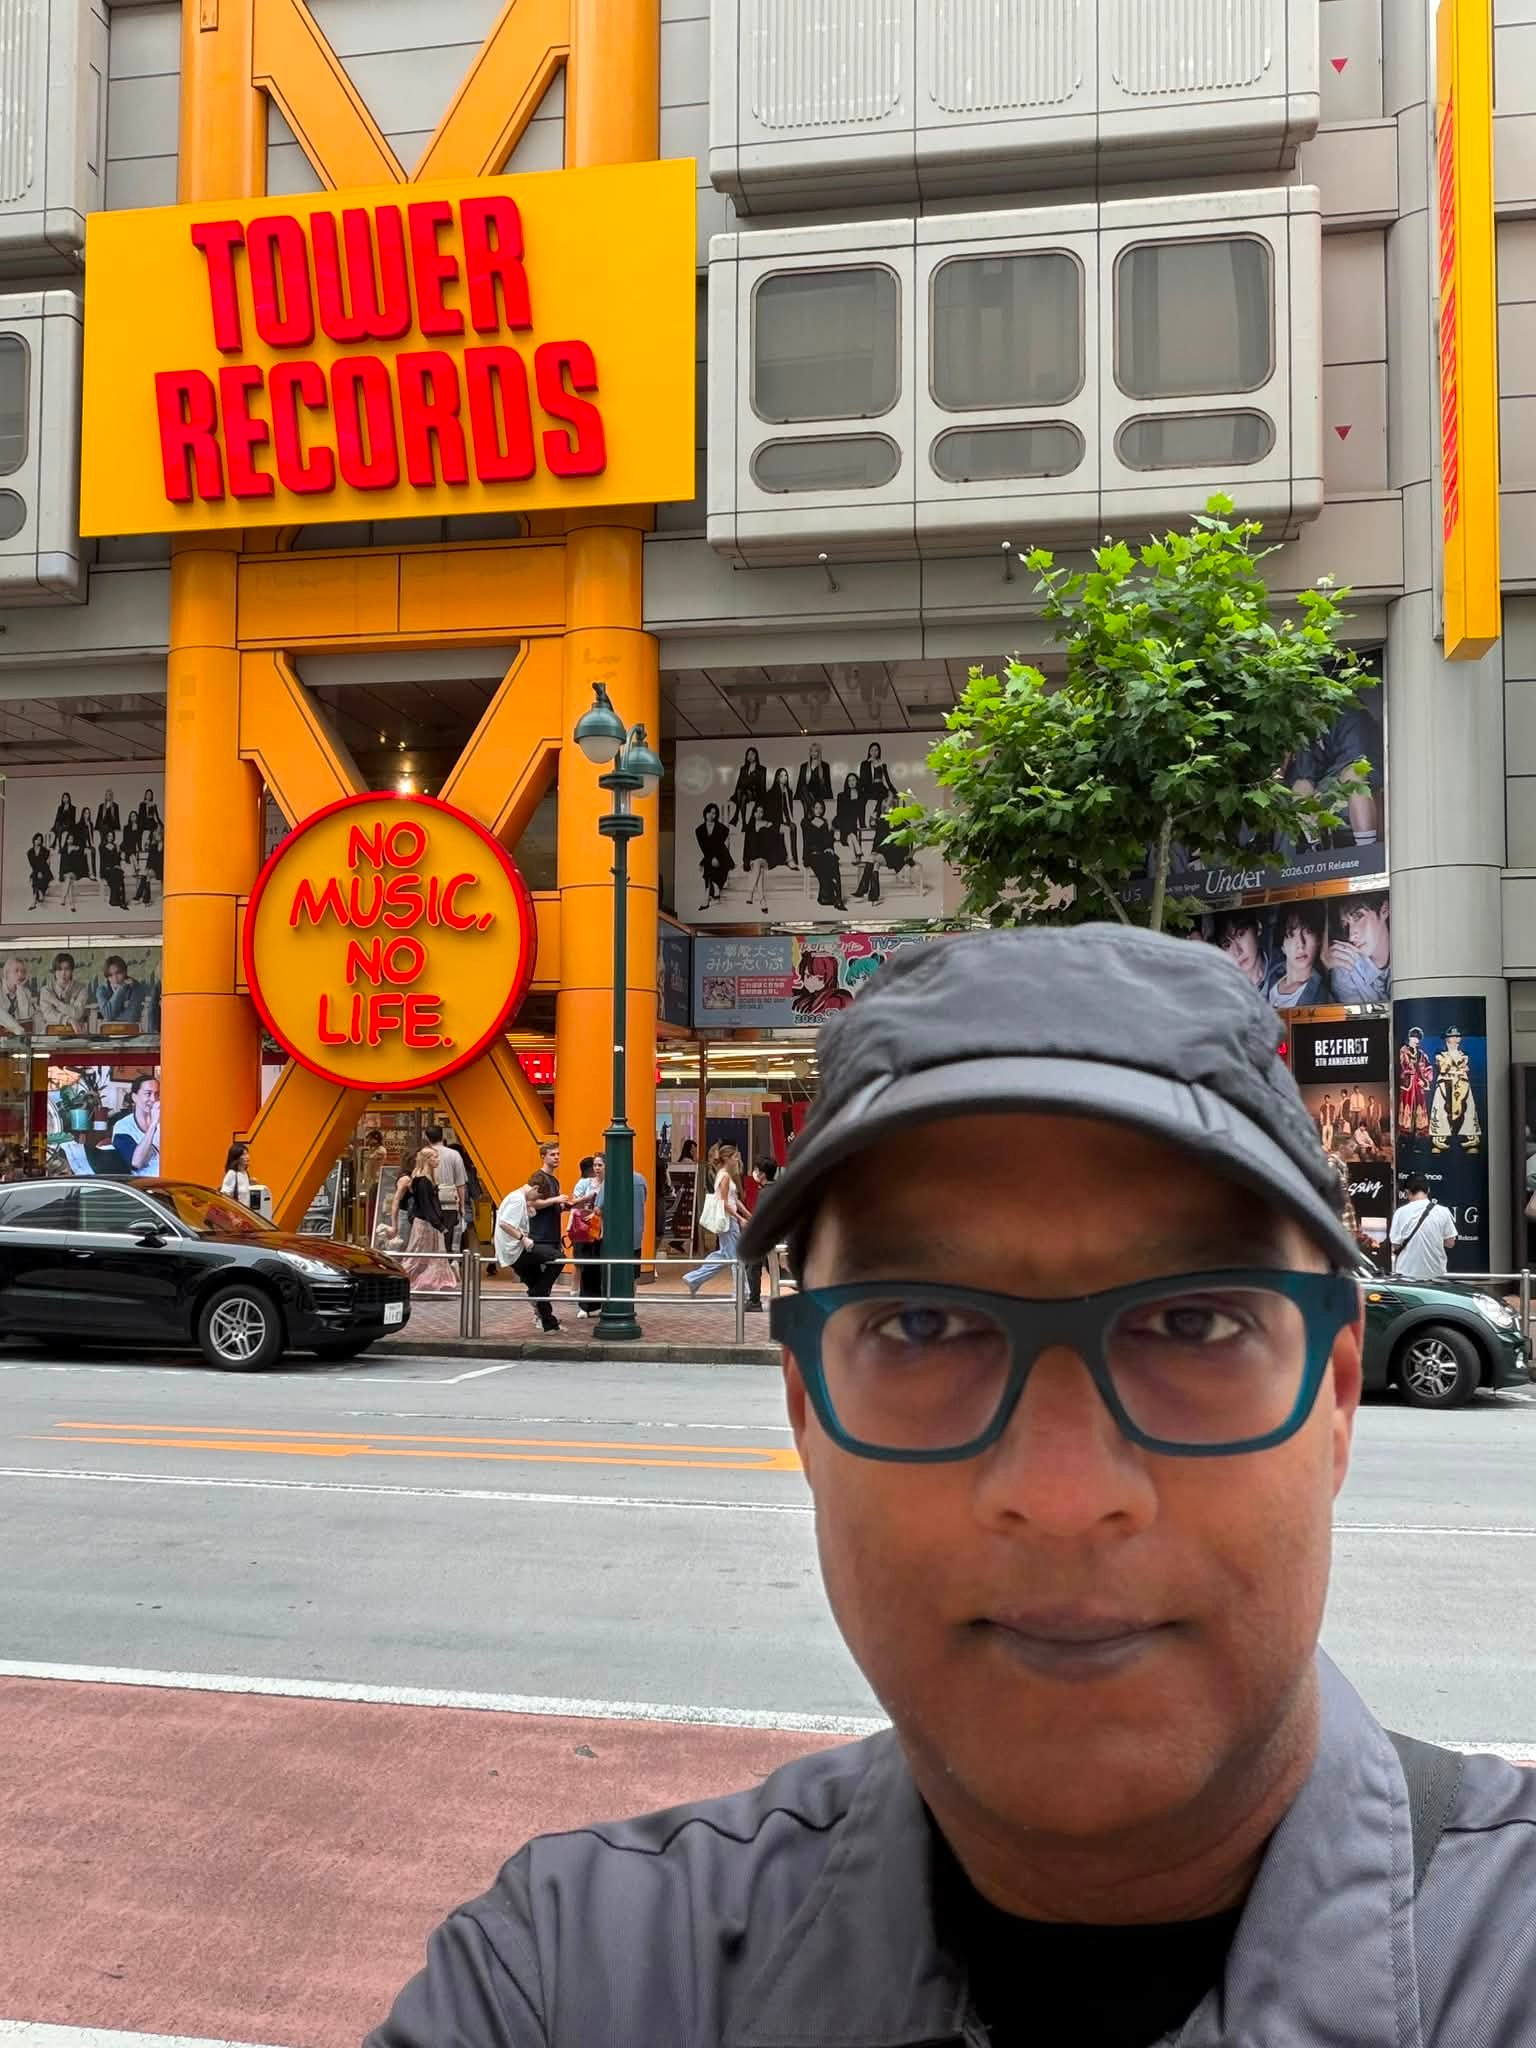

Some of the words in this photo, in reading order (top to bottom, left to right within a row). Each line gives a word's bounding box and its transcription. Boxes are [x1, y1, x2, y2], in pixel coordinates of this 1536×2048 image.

[190, 195, 533, 354] TOWER
[154, 339, 608, 501] RECORDS
[348, 820, 427, 869] NO
[1281, 862, 1327, 878] 2026.07.01
[1328, 859, 1360, 872] Release
[289, 873, 494, 931] MUSIC,
[1205, 867, 1265, 894] Under
[346, 935, 427, 985] NO
[318, 992, 454, 1048] LIFE.
[1328, 1055, 1369, 1066] ANNIVERSARY
